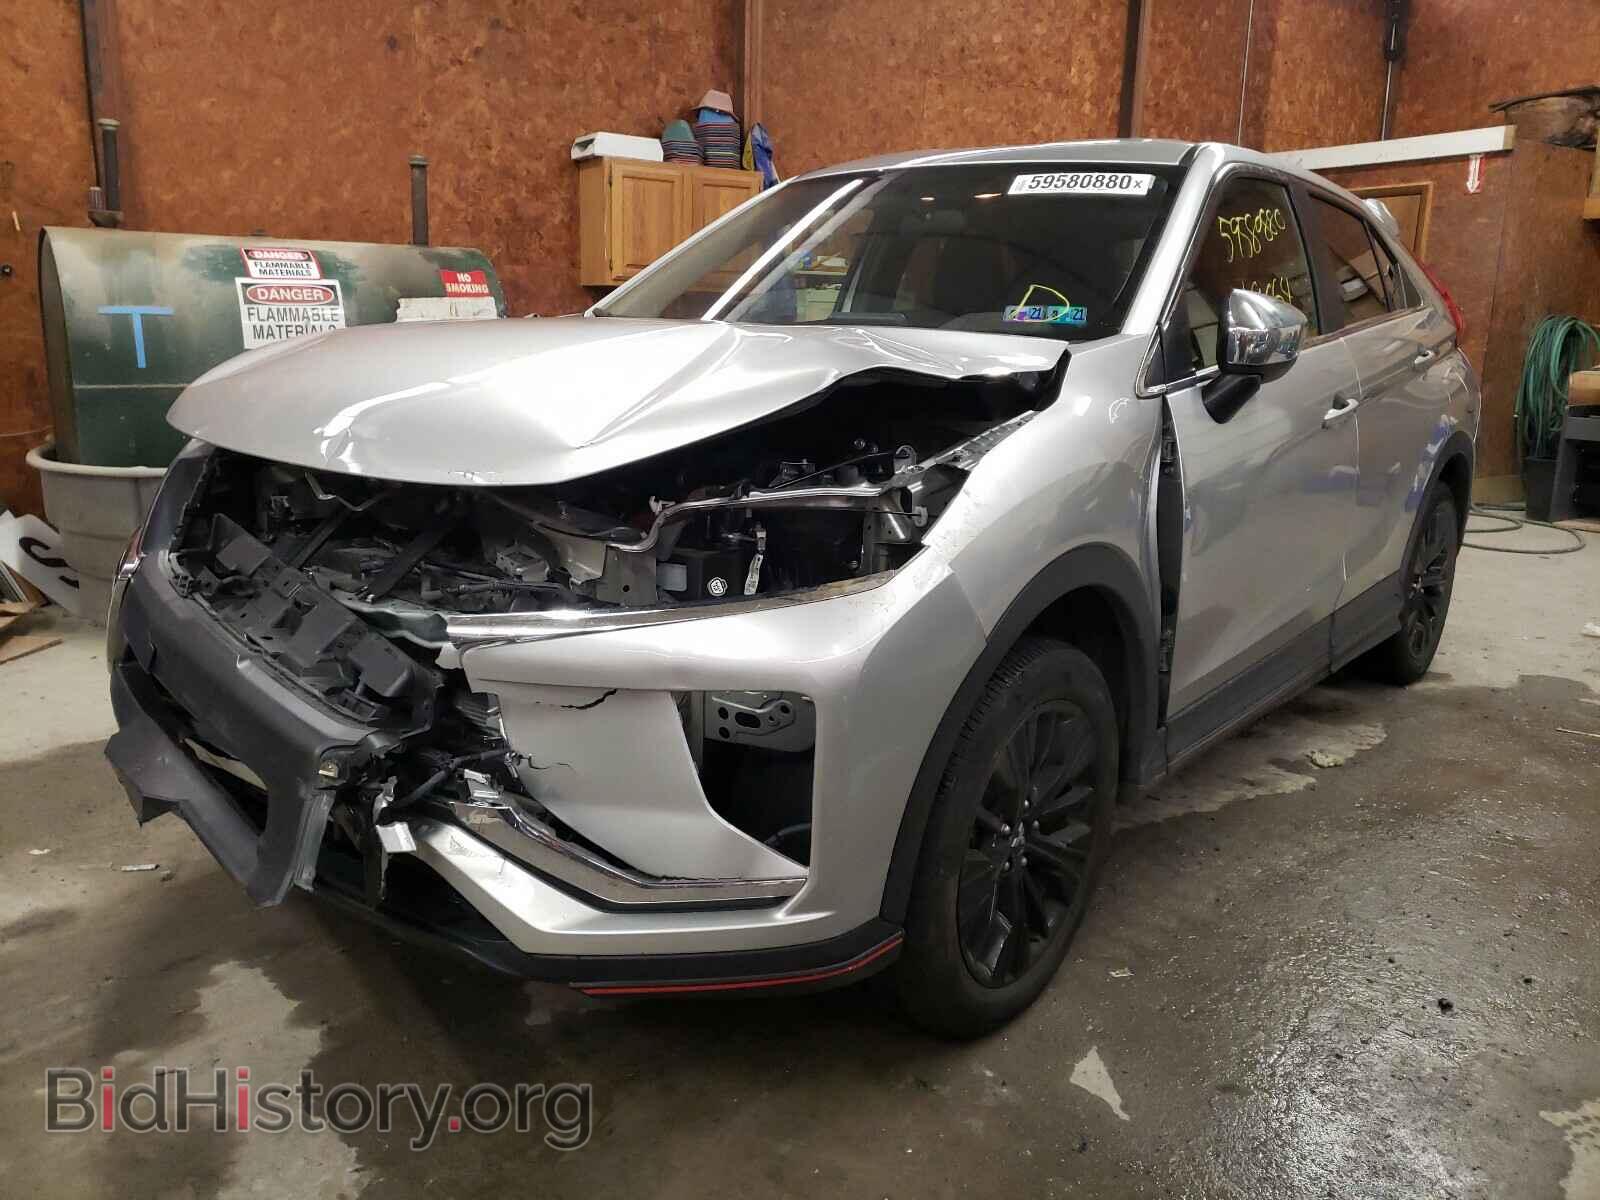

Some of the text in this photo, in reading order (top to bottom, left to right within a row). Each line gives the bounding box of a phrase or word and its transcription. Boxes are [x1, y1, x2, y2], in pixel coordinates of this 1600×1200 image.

[253, 250, 305, 260] DANGER
[254, 261, 312, 270] FLAMMABLE
[258, 268, 312, 277] MATERIALS
[456, 272, 472, 283] NO
[445, 282, 489, 294] SMOKING
[256, 287, 324, 301] DANGER
[247, 306, 340, 322] FLAMMABLE
